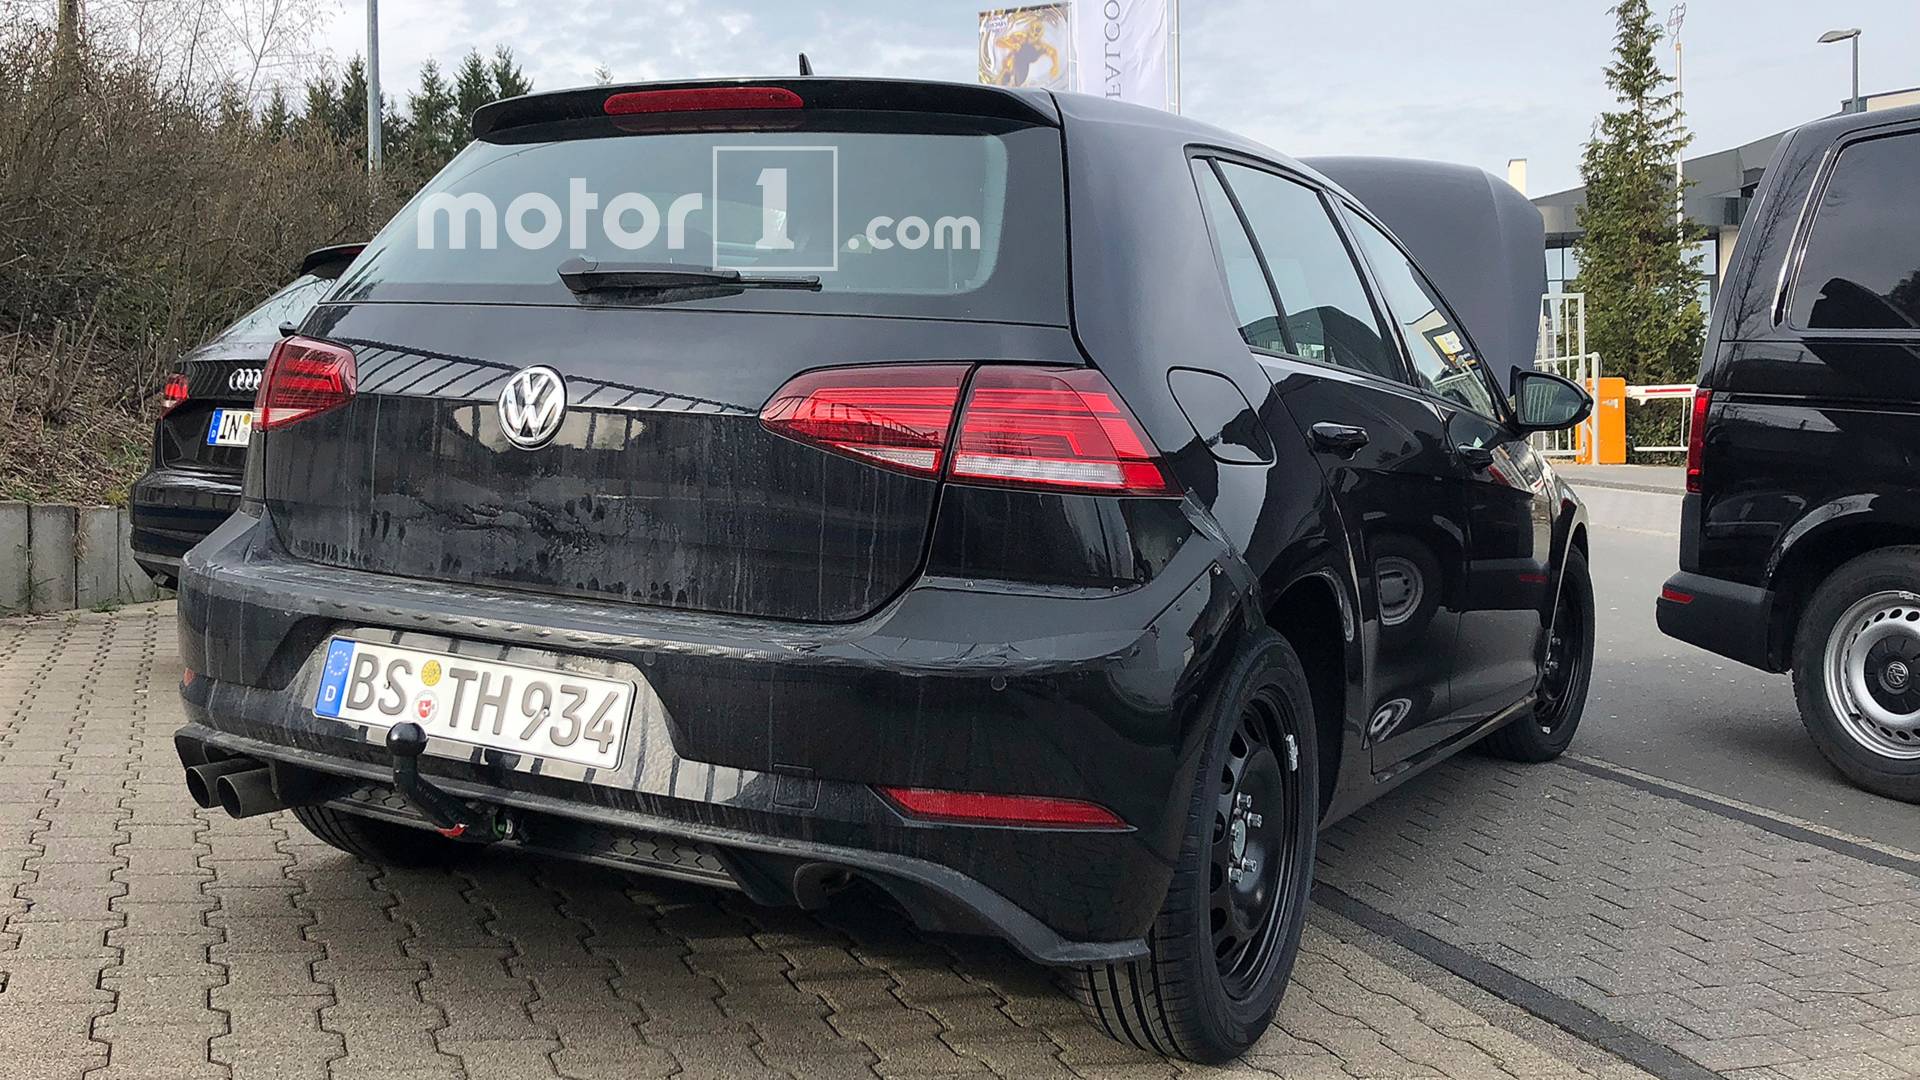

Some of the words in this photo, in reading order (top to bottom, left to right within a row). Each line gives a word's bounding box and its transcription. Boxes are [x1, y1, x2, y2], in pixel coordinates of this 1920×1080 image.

[219, 414, 241, 440] IN
[502, 370, 560, 440] VW
[324, 685, 337, 702] D
[346, 652, 413, 715] BS
